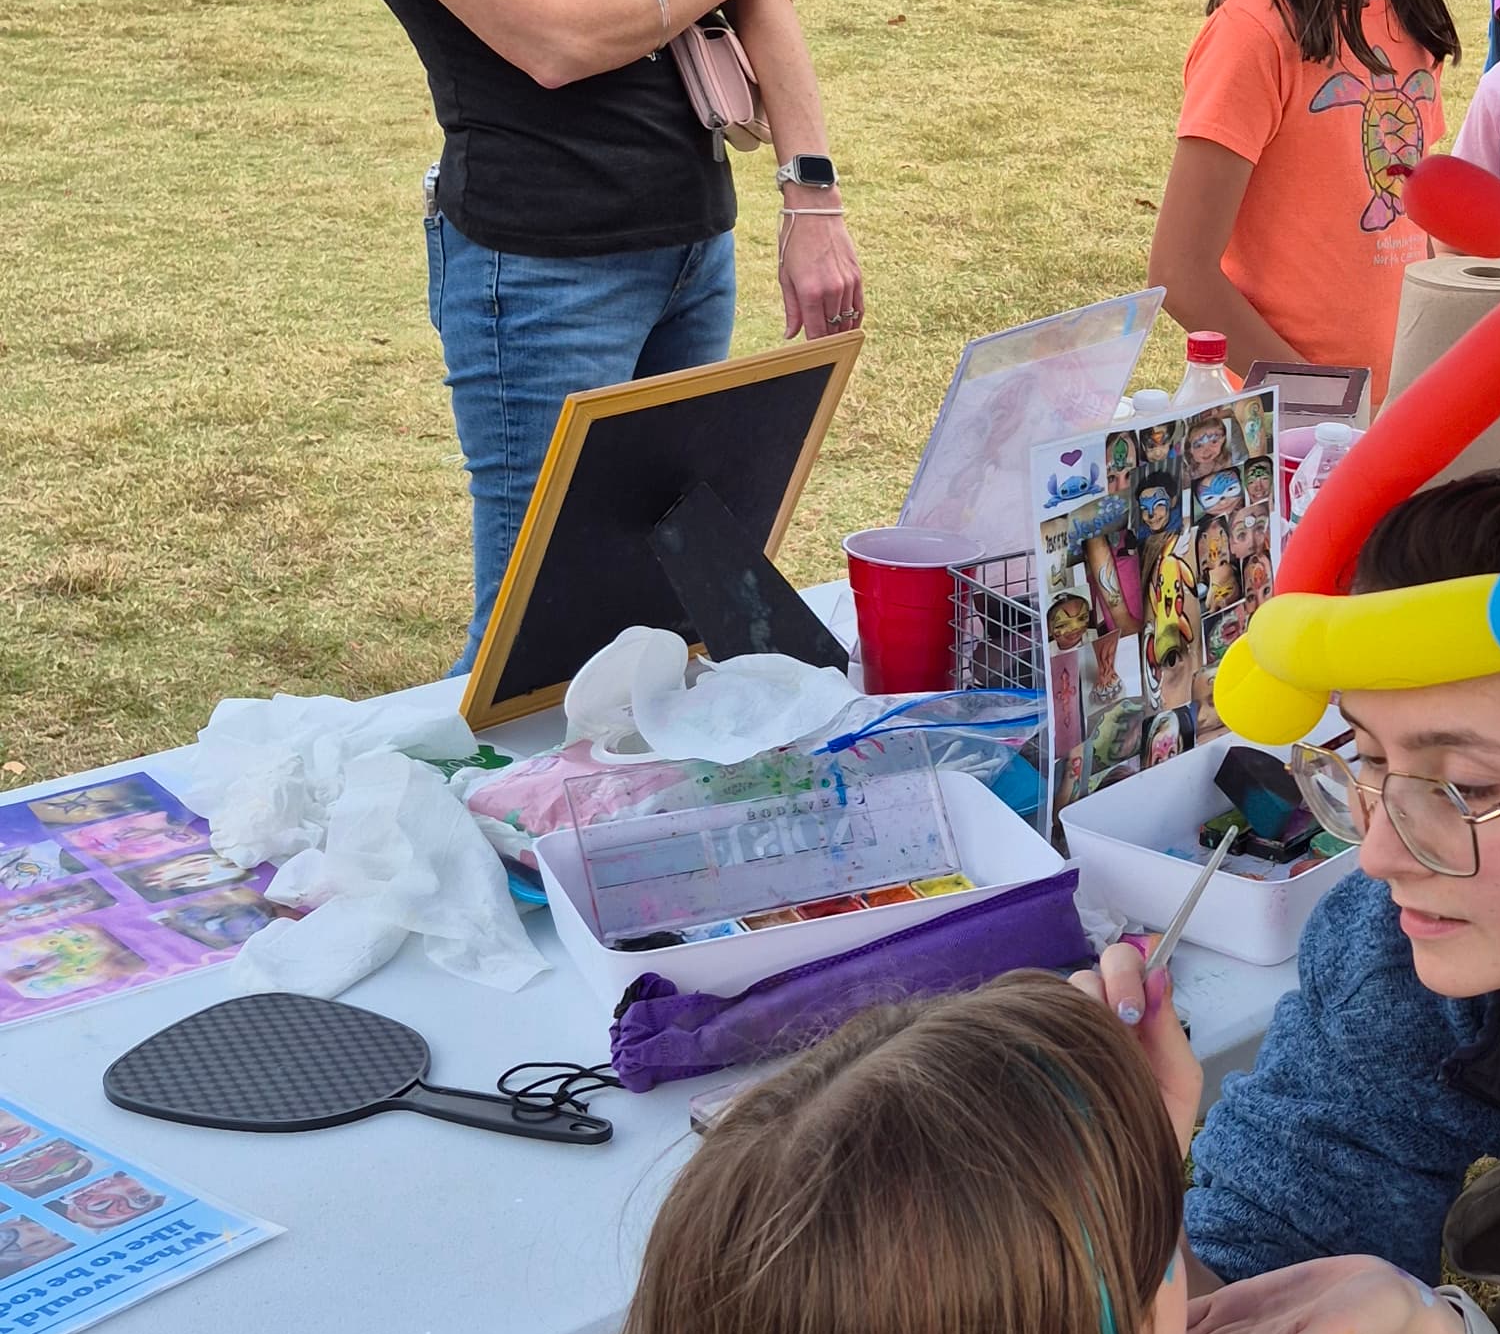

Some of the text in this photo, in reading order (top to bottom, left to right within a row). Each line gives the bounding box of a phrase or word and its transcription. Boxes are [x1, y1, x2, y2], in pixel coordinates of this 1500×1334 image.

[125, 1219, 196, 1250] like
[90, 1251, 128, 1267] to
[13, 1231, 224, 1327] What would
[46, 1267, 95, 1287] be
